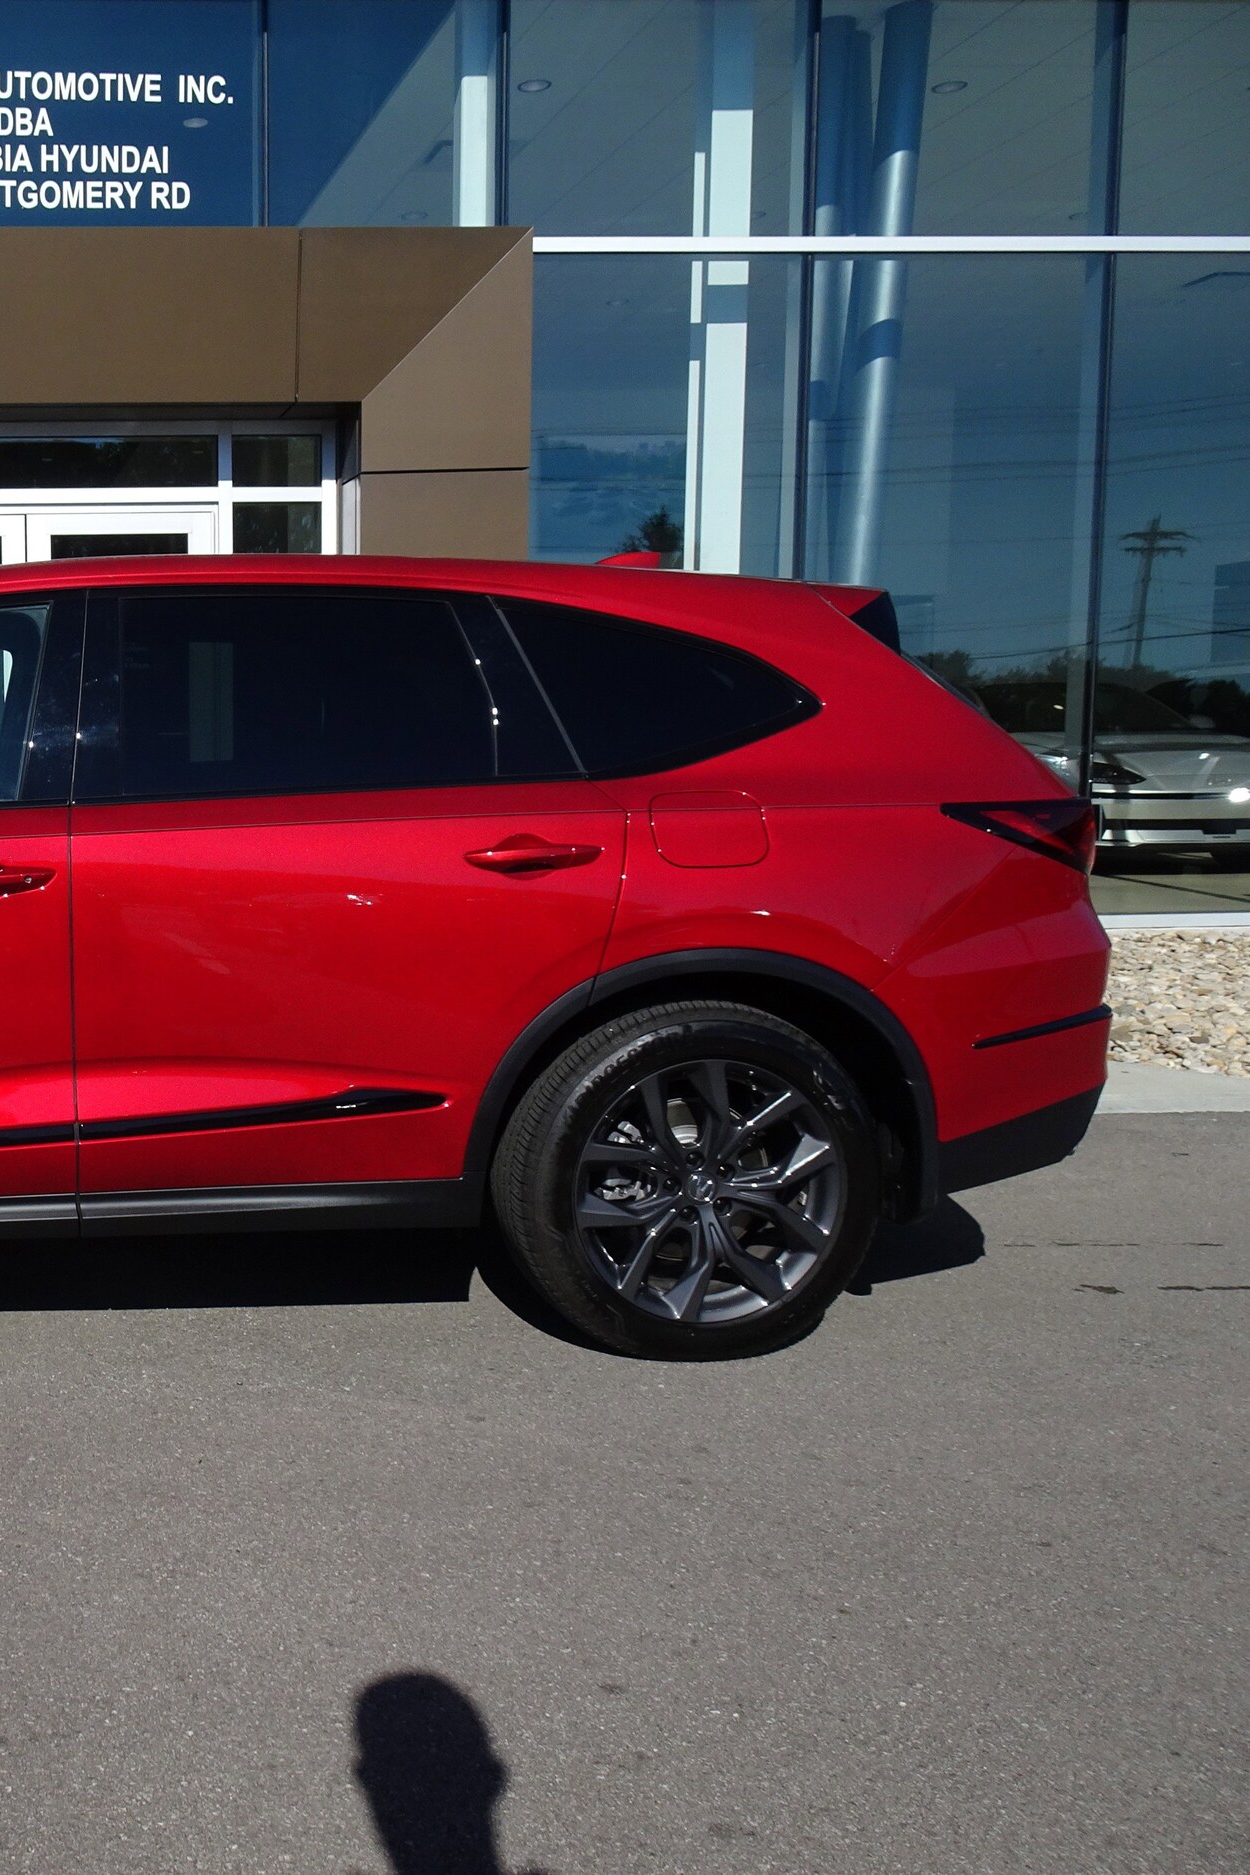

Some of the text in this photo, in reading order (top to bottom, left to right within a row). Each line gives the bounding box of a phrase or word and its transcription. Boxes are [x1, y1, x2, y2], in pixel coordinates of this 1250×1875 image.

[178, 74, 234, 104] INC.
[40, 143, 169, 174] HYUNDAI
[151, 181, 191, 210] RD
